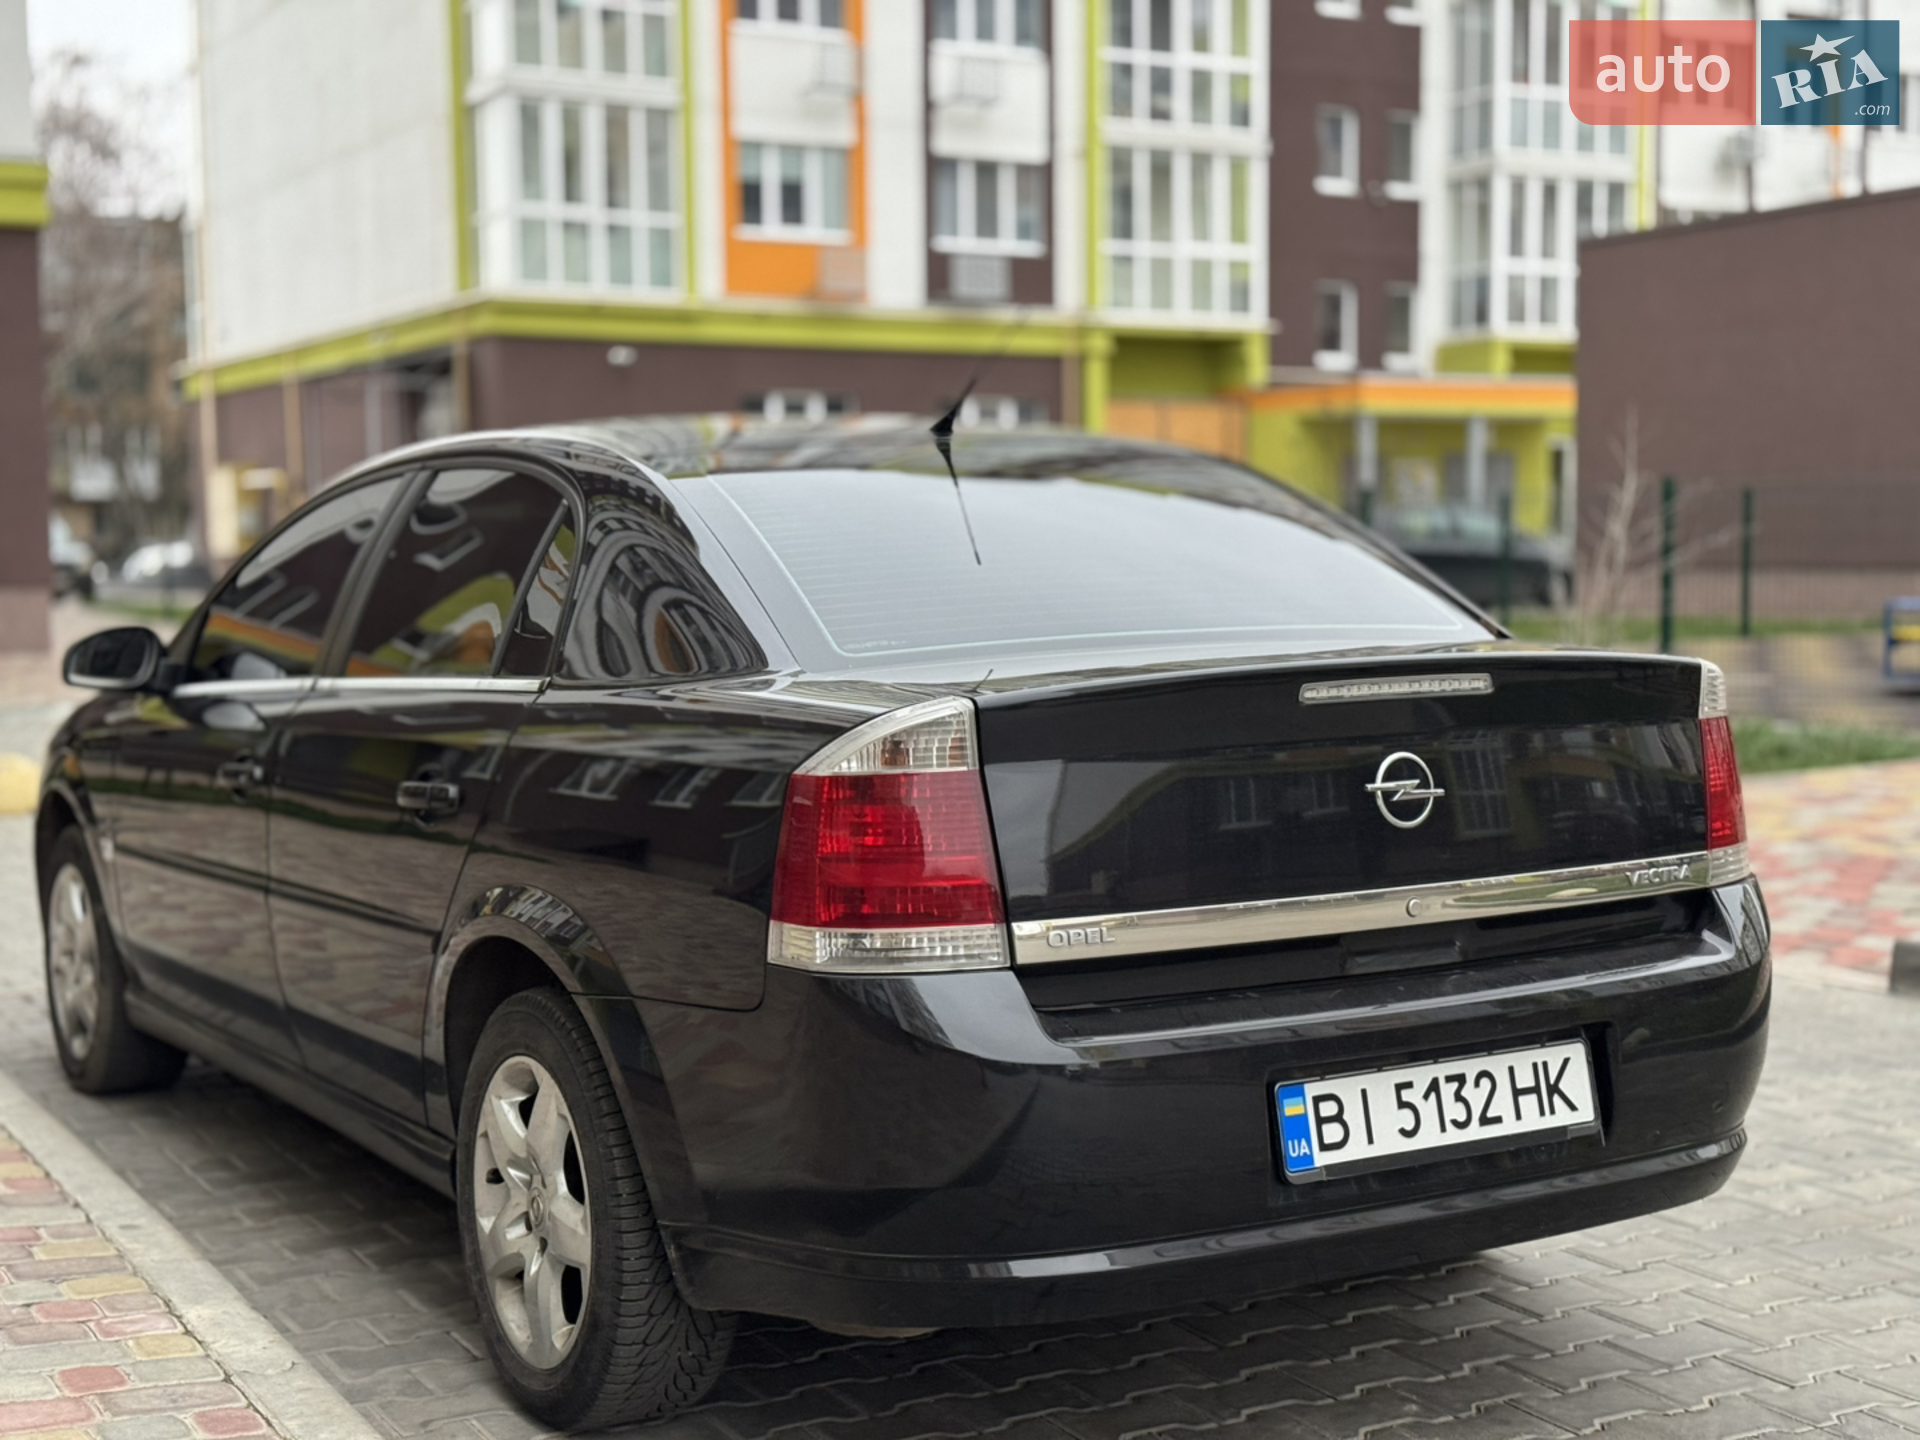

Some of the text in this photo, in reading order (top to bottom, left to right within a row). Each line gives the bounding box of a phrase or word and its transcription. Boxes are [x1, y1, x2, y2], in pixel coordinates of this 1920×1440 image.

[1625, 864, 1692, 886] VECTRA
[1047, 926, 1116, 948] OPEL
[1288, 1138, 1311, 1158] UA
